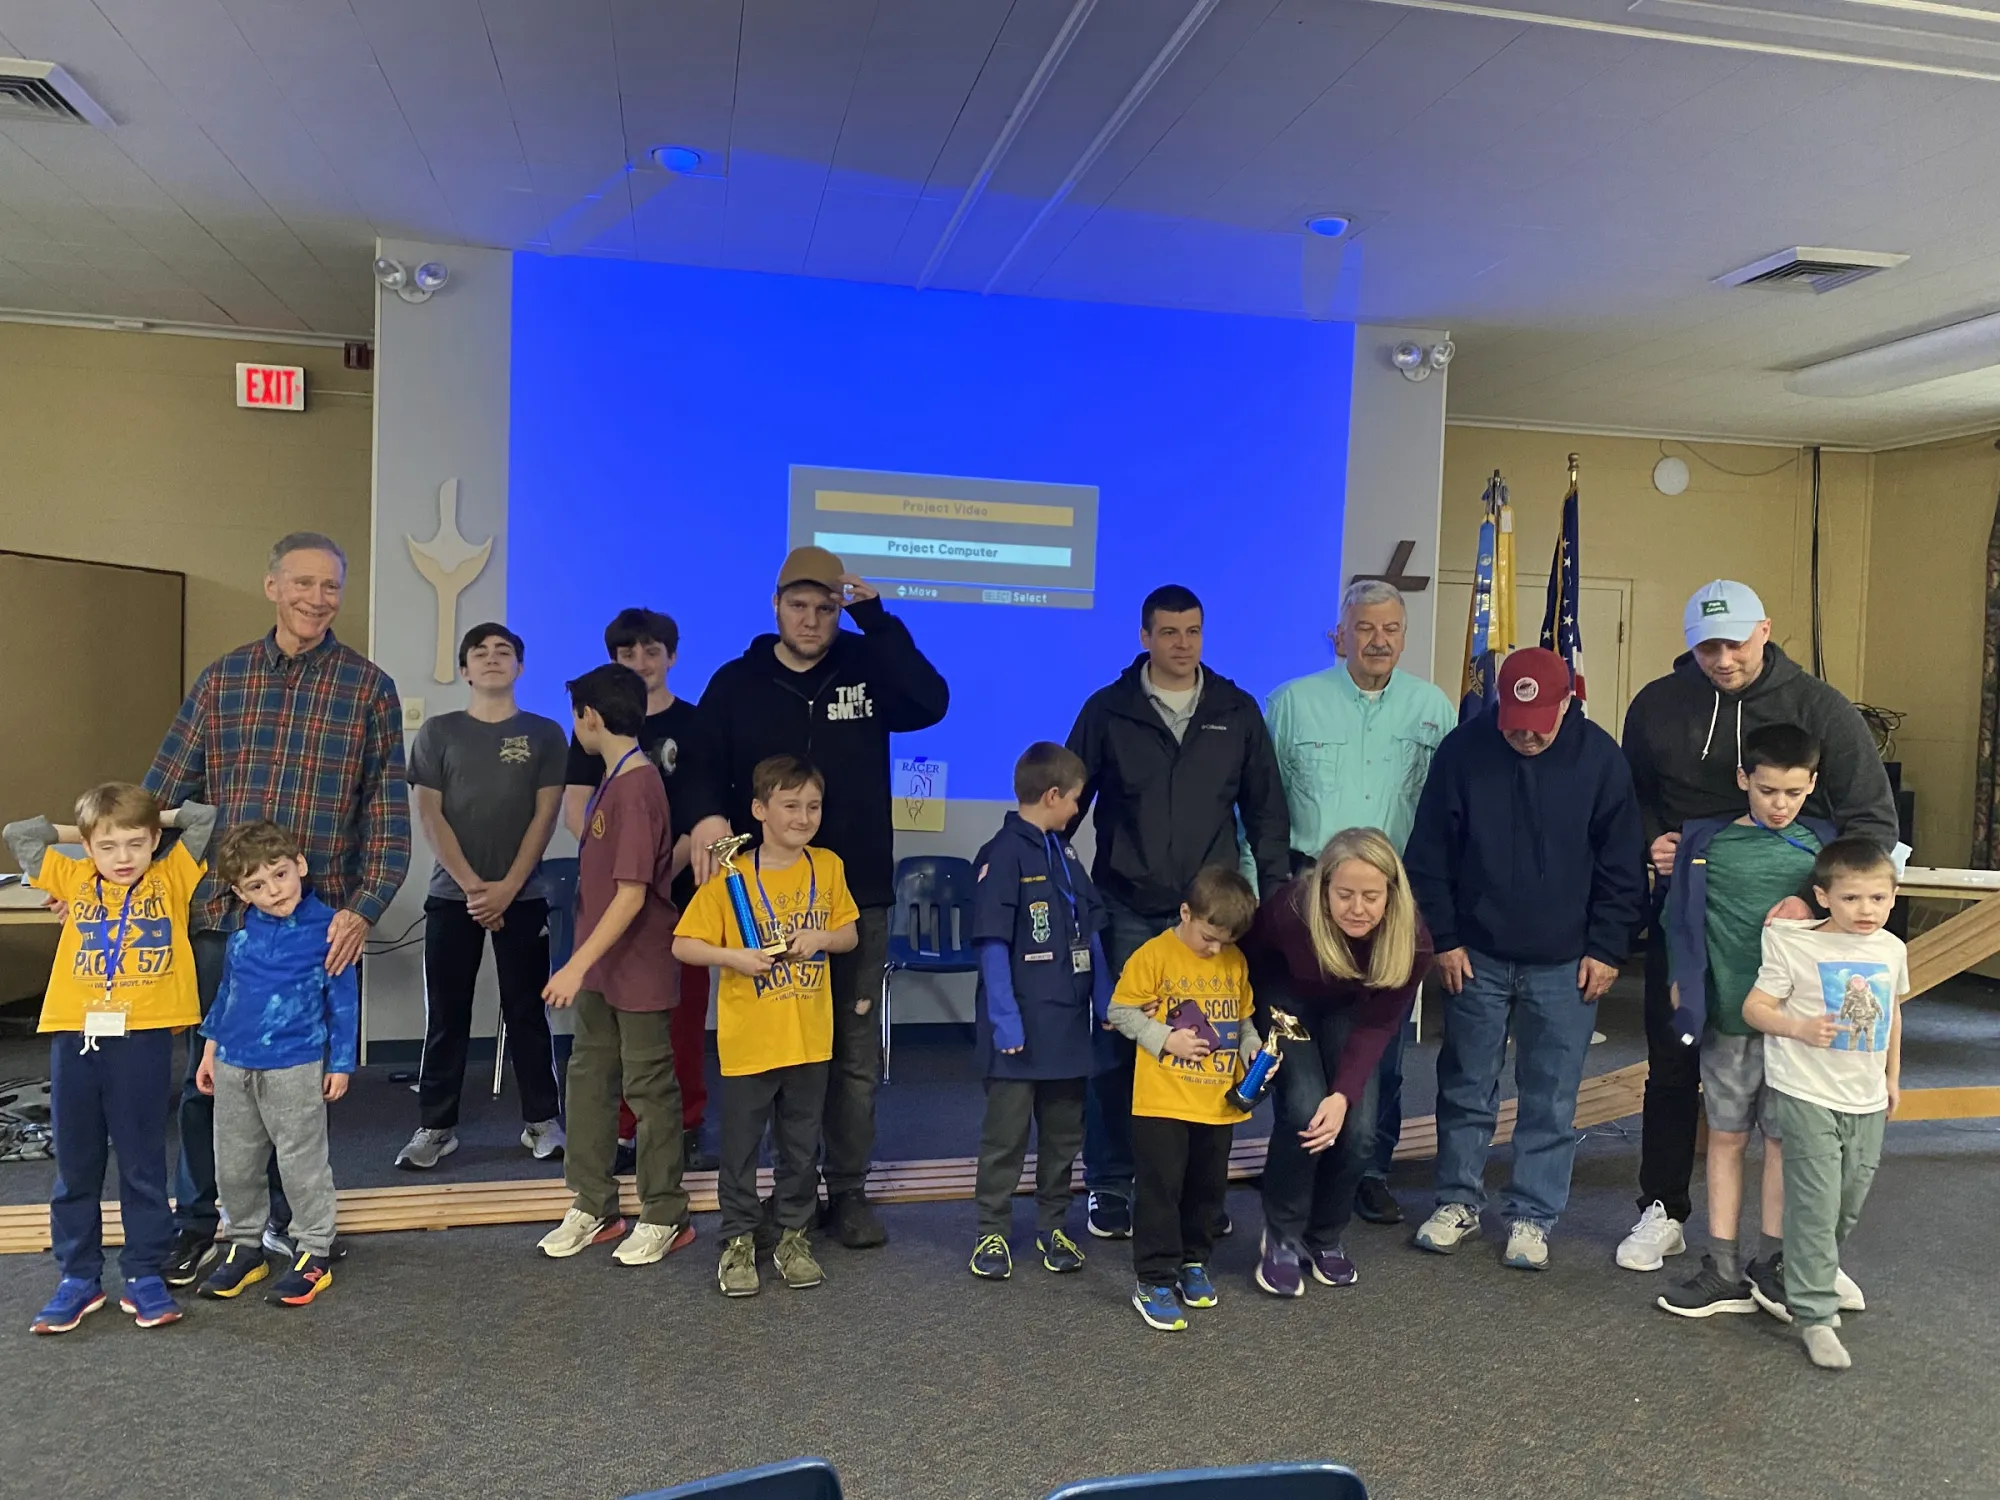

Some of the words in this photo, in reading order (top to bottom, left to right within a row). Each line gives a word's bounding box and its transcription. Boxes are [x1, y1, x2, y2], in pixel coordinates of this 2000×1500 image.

[246, 368, 296, 405] EXIT
[903, 500, 949, 514] Project
[954, 503, 988, 516] Video
[888, 540, 934, 555] Project
[938, 544, 998, 558] Computer
[908, 586, 938, 598] Move
[1012, 592, 1048, 604] Select
[835, 682, 866, 703] THE
[902, 762, 940, 774] RACER
[1205, 998, 1239, 1019] SCOU
